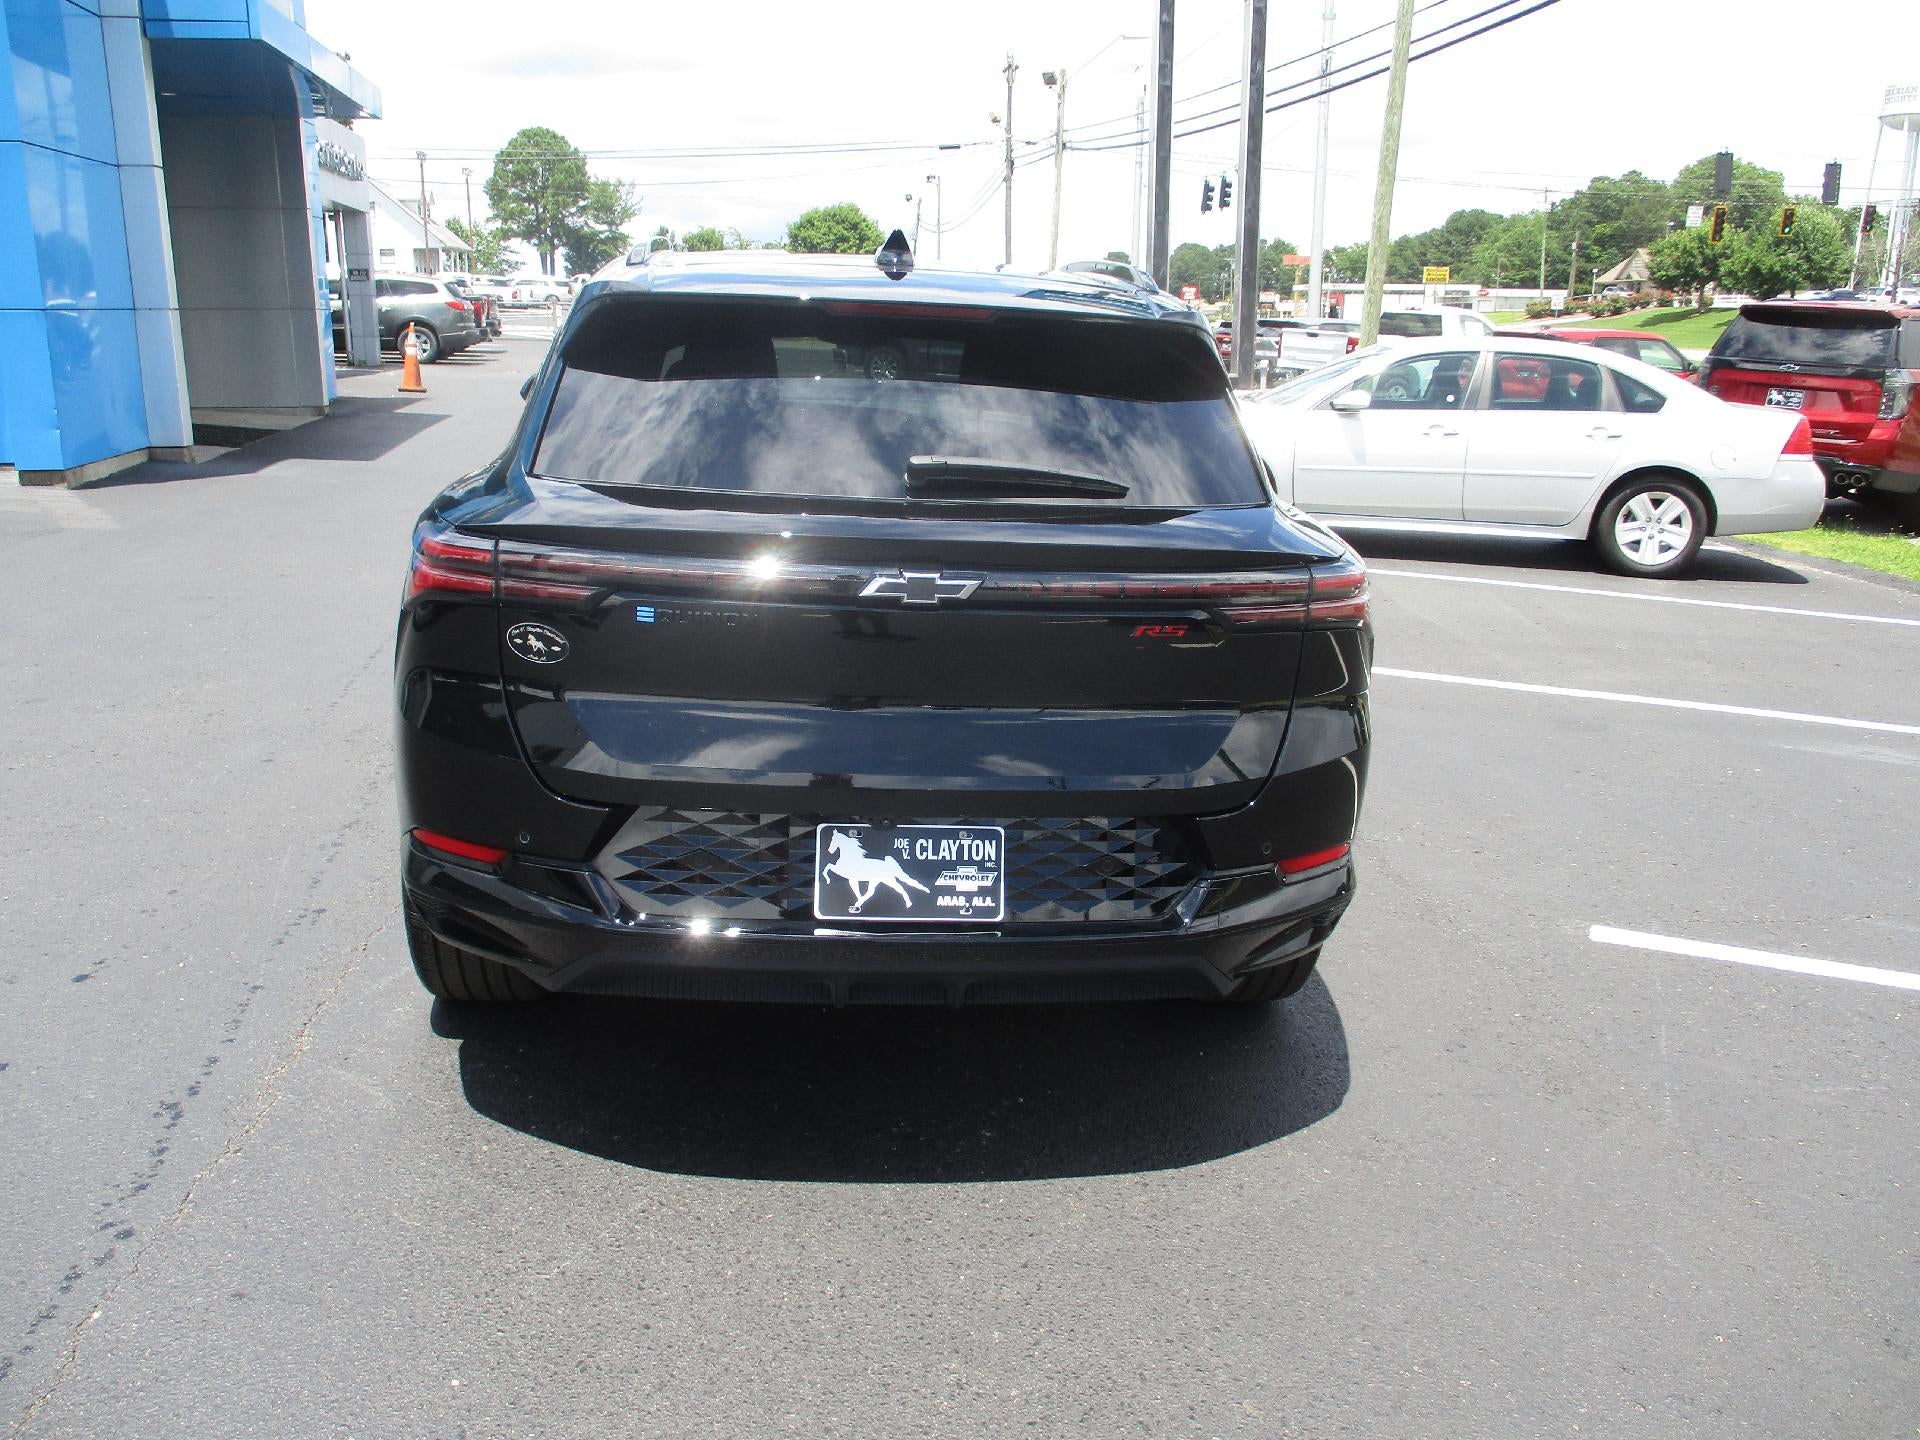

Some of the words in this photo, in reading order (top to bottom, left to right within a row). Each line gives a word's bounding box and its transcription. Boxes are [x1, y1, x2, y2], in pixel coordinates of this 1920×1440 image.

[1129, 625, 1188, 640] RS
[893, 838, 910, 849] JOE
[915, 838, 997, 861] CLAYTON
[902, 848, 911, 860] V.
[943, 874, 991, 882] CHEVROLET
[936, 895, 970, 907] ARAB,
[972, 895, 996, 907] ALA.
